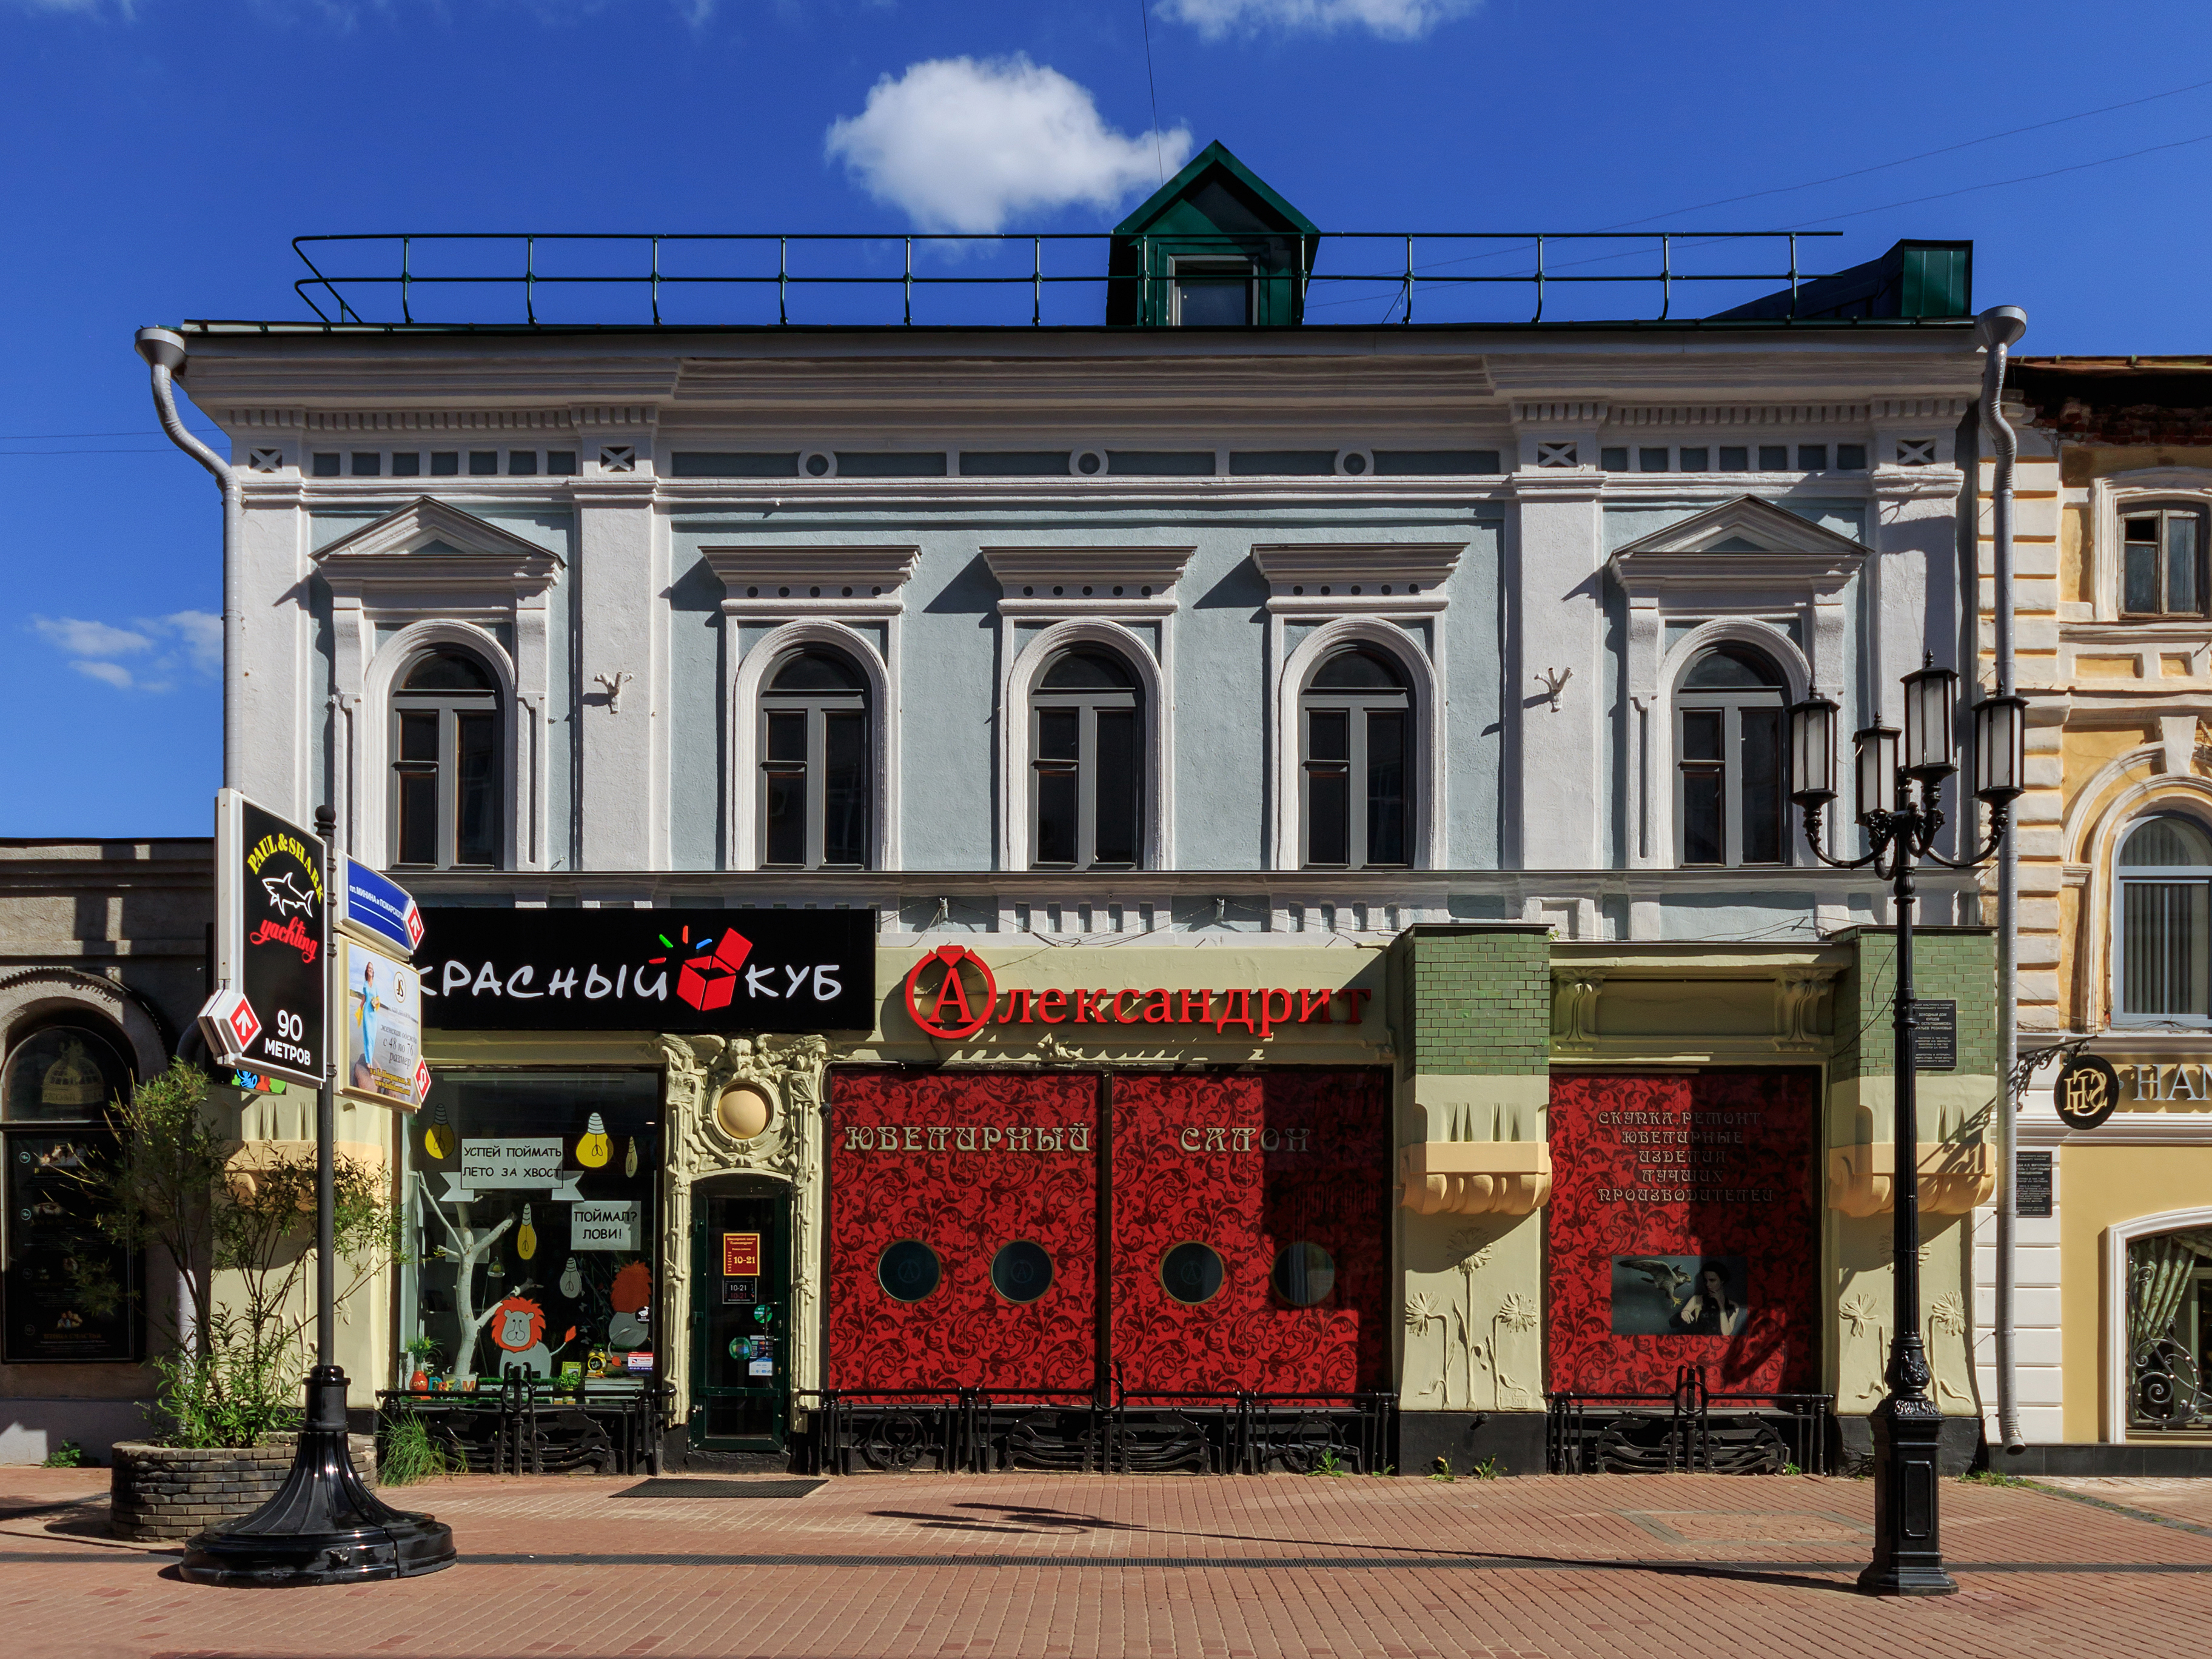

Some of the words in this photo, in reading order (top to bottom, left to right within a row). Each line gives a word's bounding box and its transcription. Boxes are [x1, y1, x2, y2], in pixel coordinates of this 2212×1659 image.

[250, 916, 318, 963] yachting
[745, 964, 842, 1000] КУБ
[926, 967, 1372, 1037] Александрит
[278, 1010, 303, 1041] 90
[264, 1037, 310, 1066] МЕТРОВ
[389, 1037, 397, 1050] 48
[407, 1043, 414, 1056] 76
[389, 1052, 412, 1069] размер
[845, 1123, 1090, 1152] ЮВЕЛИРНЫЙ
[1181, 1127, 1310, 1151] САЛОН
[1622, 1131, 1743, 1144] ЮВЕЛИРНЫЕ
[464, 1145, 500, 1157] УСПЕЙ
[506, 1145, 561, 1157] ПОЙМАТЬ
[1639, 1150, 1726, 1163] ИЗДЕЛИЯ
[463, 1167, 494, 1176] ЛЕТО
[501, 1168, 517, 1176] ЗА
[523, 1168, 561, 1178] ХВОСТ
[1643, 1170, 1723, 1182] ЛУЧШИХ
[574, 1208, 638, 1222] ПОЙМАЛ?
[582, 1228, 622, 1239] ЛОВИ!
